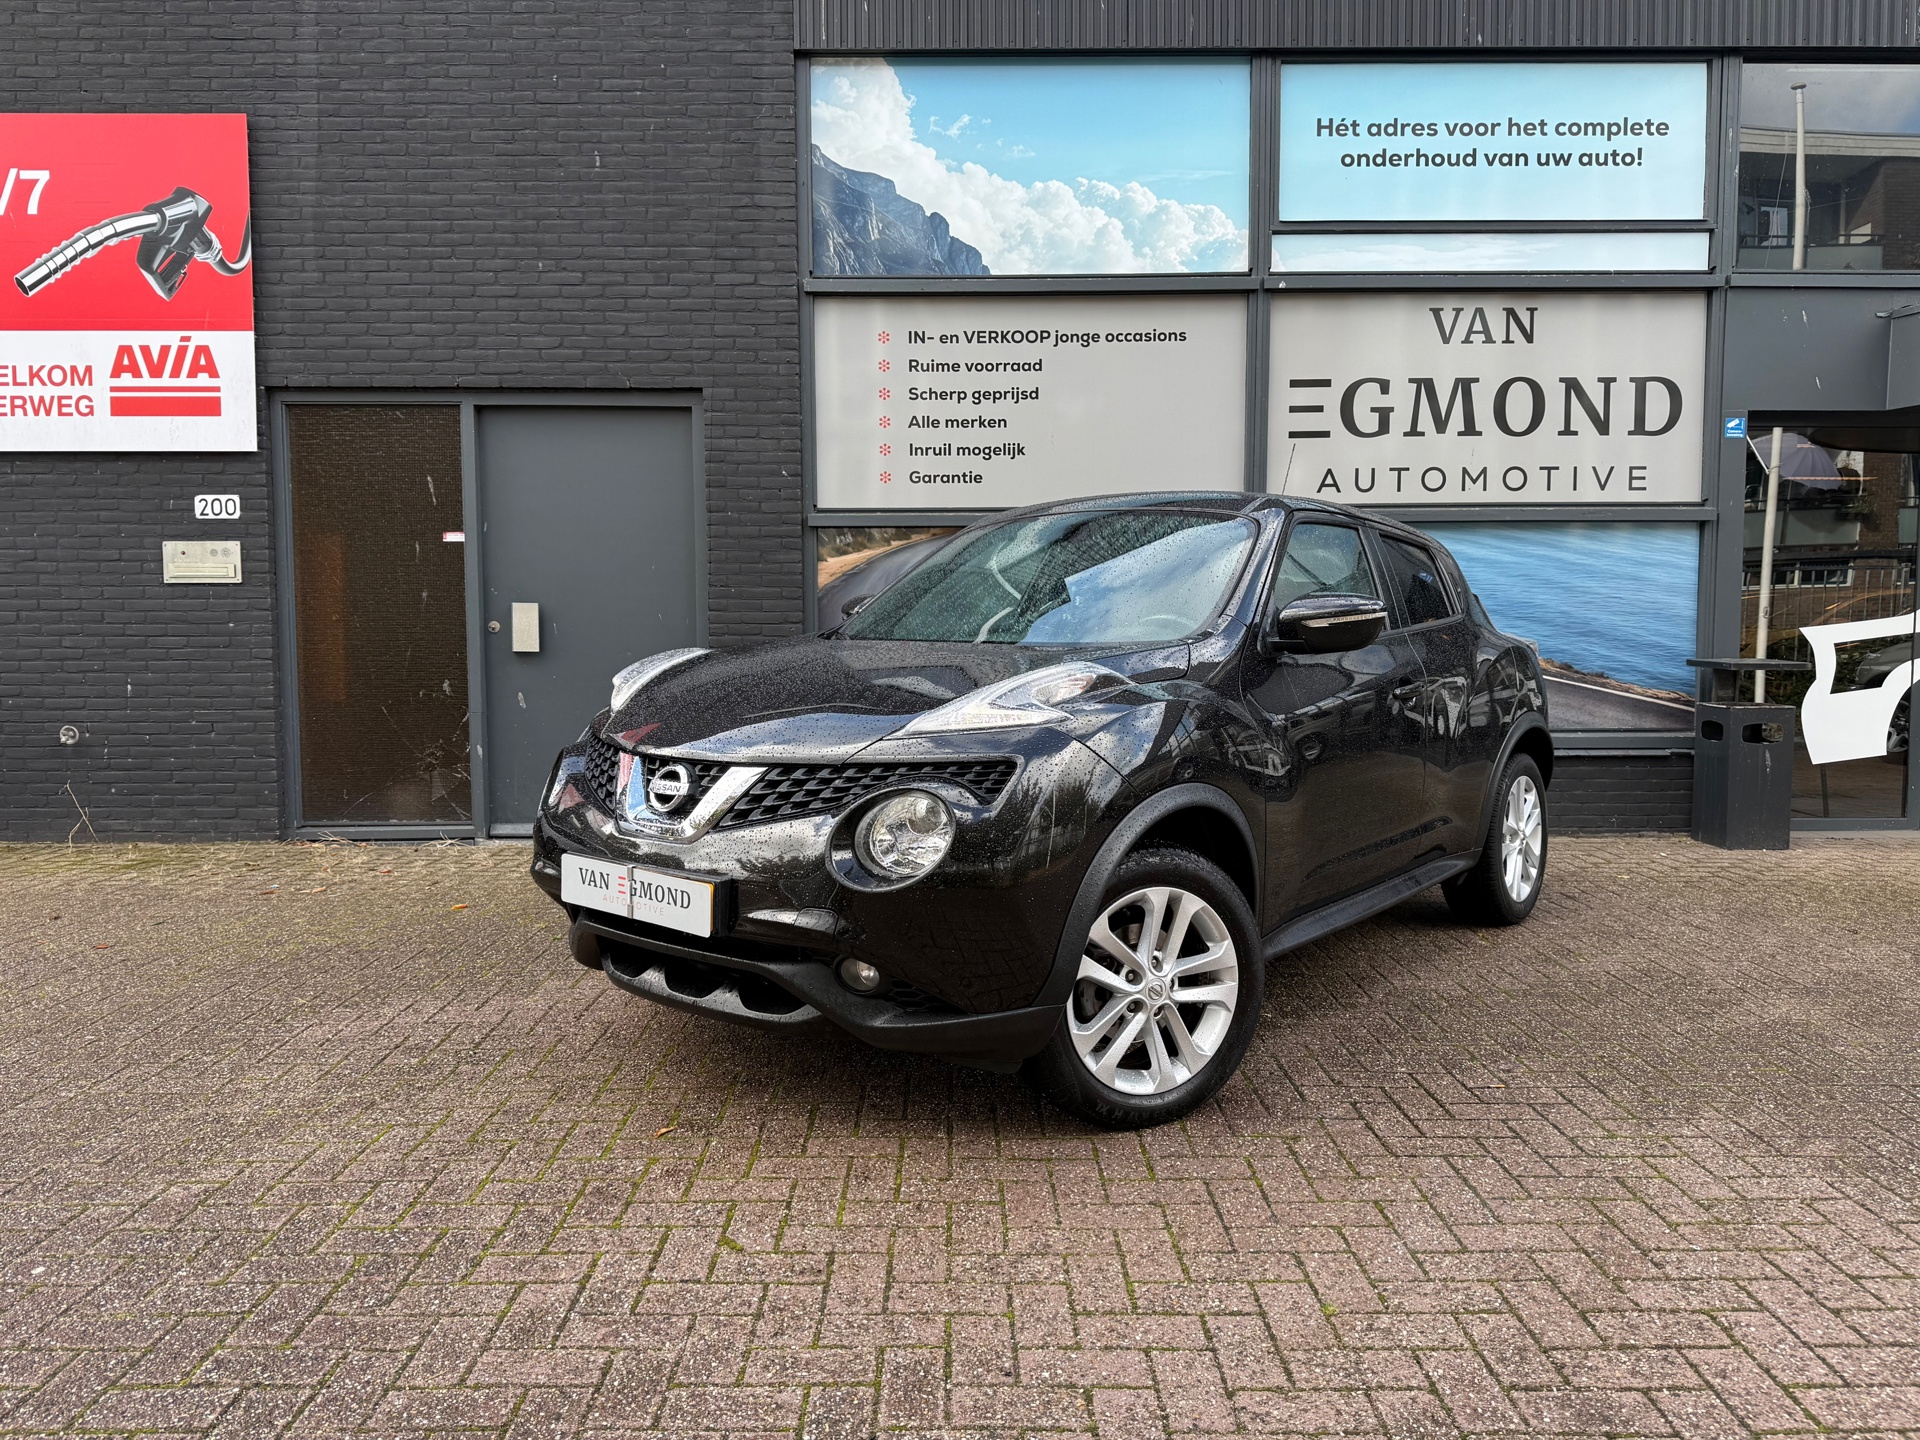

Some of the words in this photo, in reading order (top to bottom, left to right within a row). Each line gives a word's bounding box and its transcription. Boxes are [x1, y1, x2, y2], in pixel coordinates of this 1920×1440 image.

[1316, 117, 1360, 137] Hét
[1366, 117, 1438, 137] adres
[1444, 122, 1501, 137] voor
[1507, 117, 1548, 137] het
[1554, 116, 1670, 141] complete
[1340, 147, 1477, 168] onderhoud
[1484, 152, 1529, 167] van
[1536, 152, 1572, 167] uw
[1578, 147, 1643, 167] auto!
[1429, 307, 1538, 344] VAN
[908, 331, 934, 345] IN-
[939, 334, 959, 345] en
[963, 330, 1051, 345] VERKOOP
[1054, 330, 1100, 347] jonge
[1105, 328, 1187, 343] occasions
[908, 359, 961, 373] Ruime
[965, 358, 1042, 373] voorraad
[908, 387, 967, 404] Scherp
[972, 386, 1039, 405] geprijsd
[1288, 376, 1683, 439] EGMOND
[908, 415, 940, 429] Alle
[945, 415, 1007, 429] merken
[909, 442, 952, 457] Inruil
[956, 443, 1026, 460] mogelijk
[908, 470, 983, 485] Garantie
[1316, 465, 1648, 494] AUTOMOTIVE
[198, 498, 237, 517] 200
[578, 867, 610, 891] VAN
[602, 894, 664, 916] AUTOOTIVE
